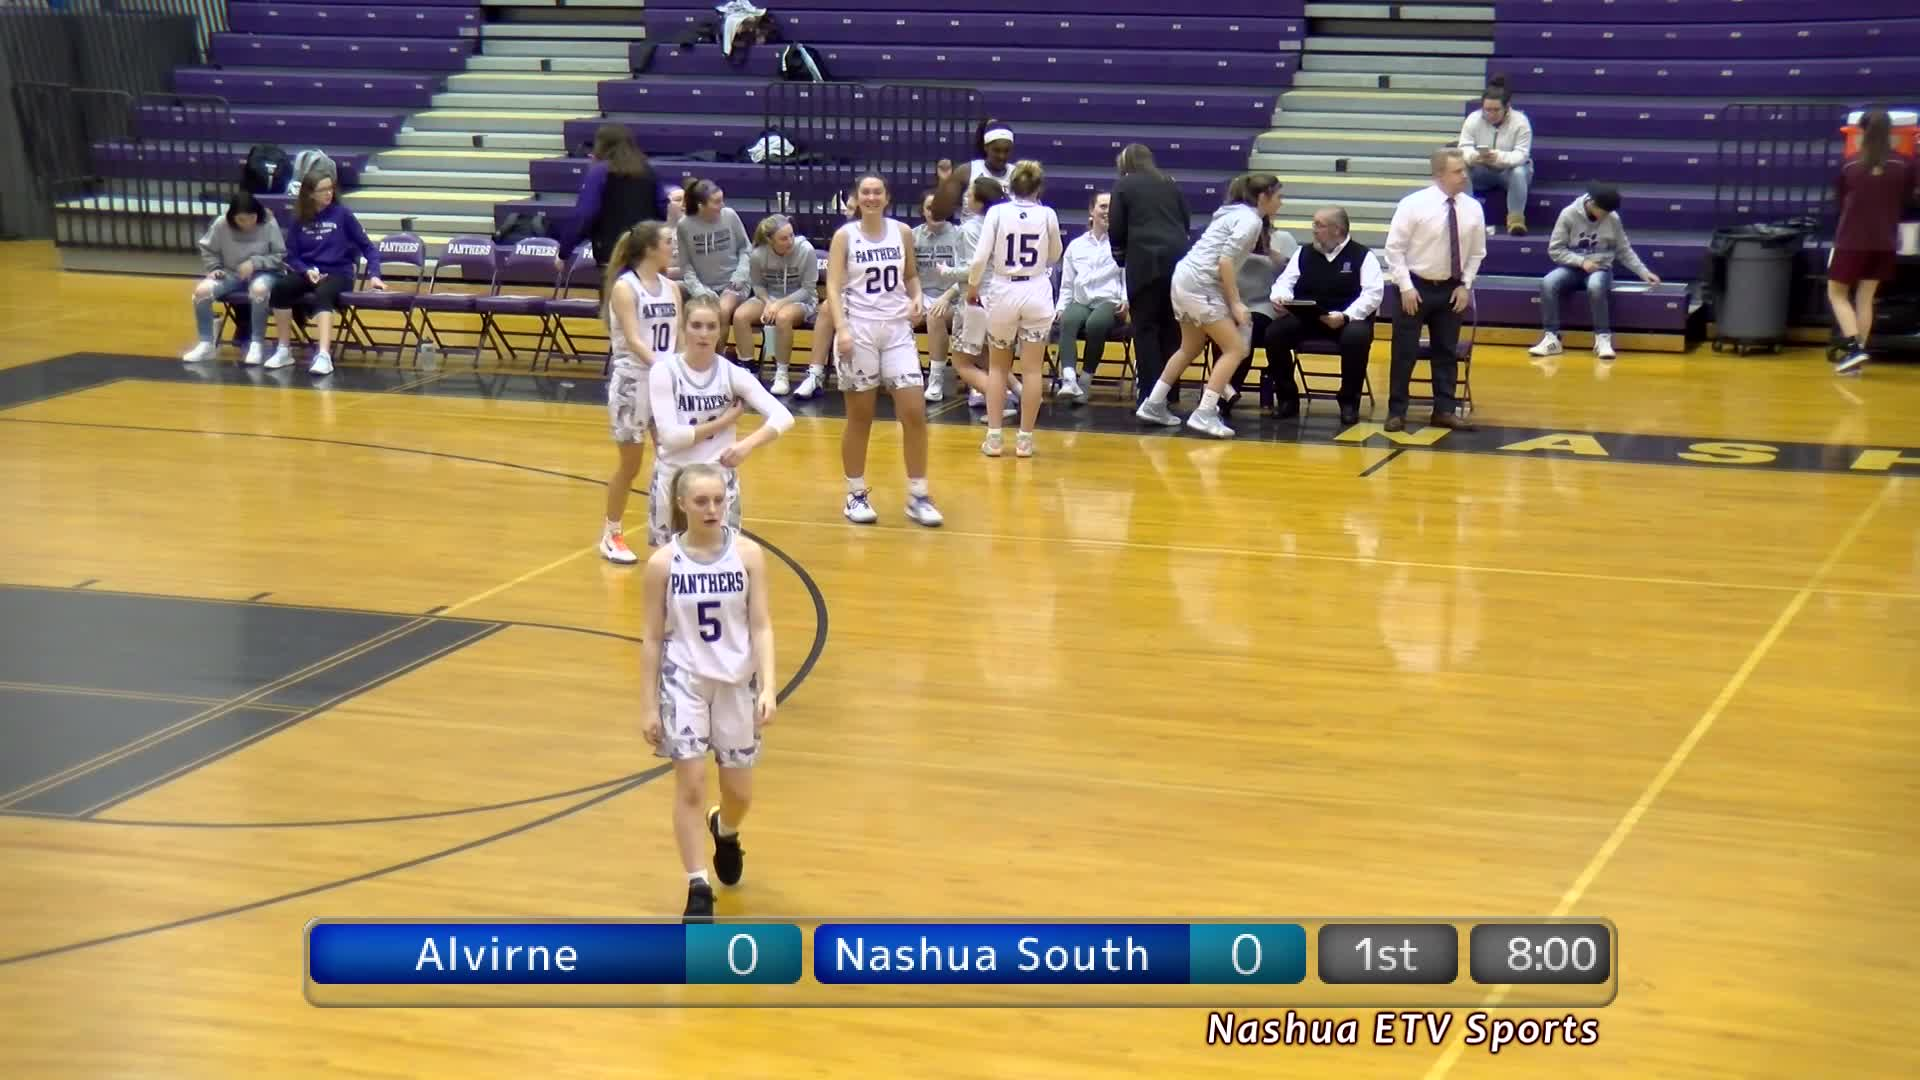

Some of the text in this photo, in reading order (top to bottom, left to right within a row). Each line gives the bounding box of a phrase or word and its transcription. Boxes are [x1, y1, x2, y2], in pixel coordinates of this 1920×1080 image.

[378, 242, 420, 253] PANTHERS
[447, 243, 491, 256] PANTHERS
[515, 244, 558, 257] PANTHERS
[1004, 232, 1040, 268] 15
[865, 264, 899, 294] 20
[651, 322, 671, 352] 10
[678, 393, 732, 412] ANTHERS
[671, 571, 744, 595] PANTHERS
[697, 600, 722, 643] 5
